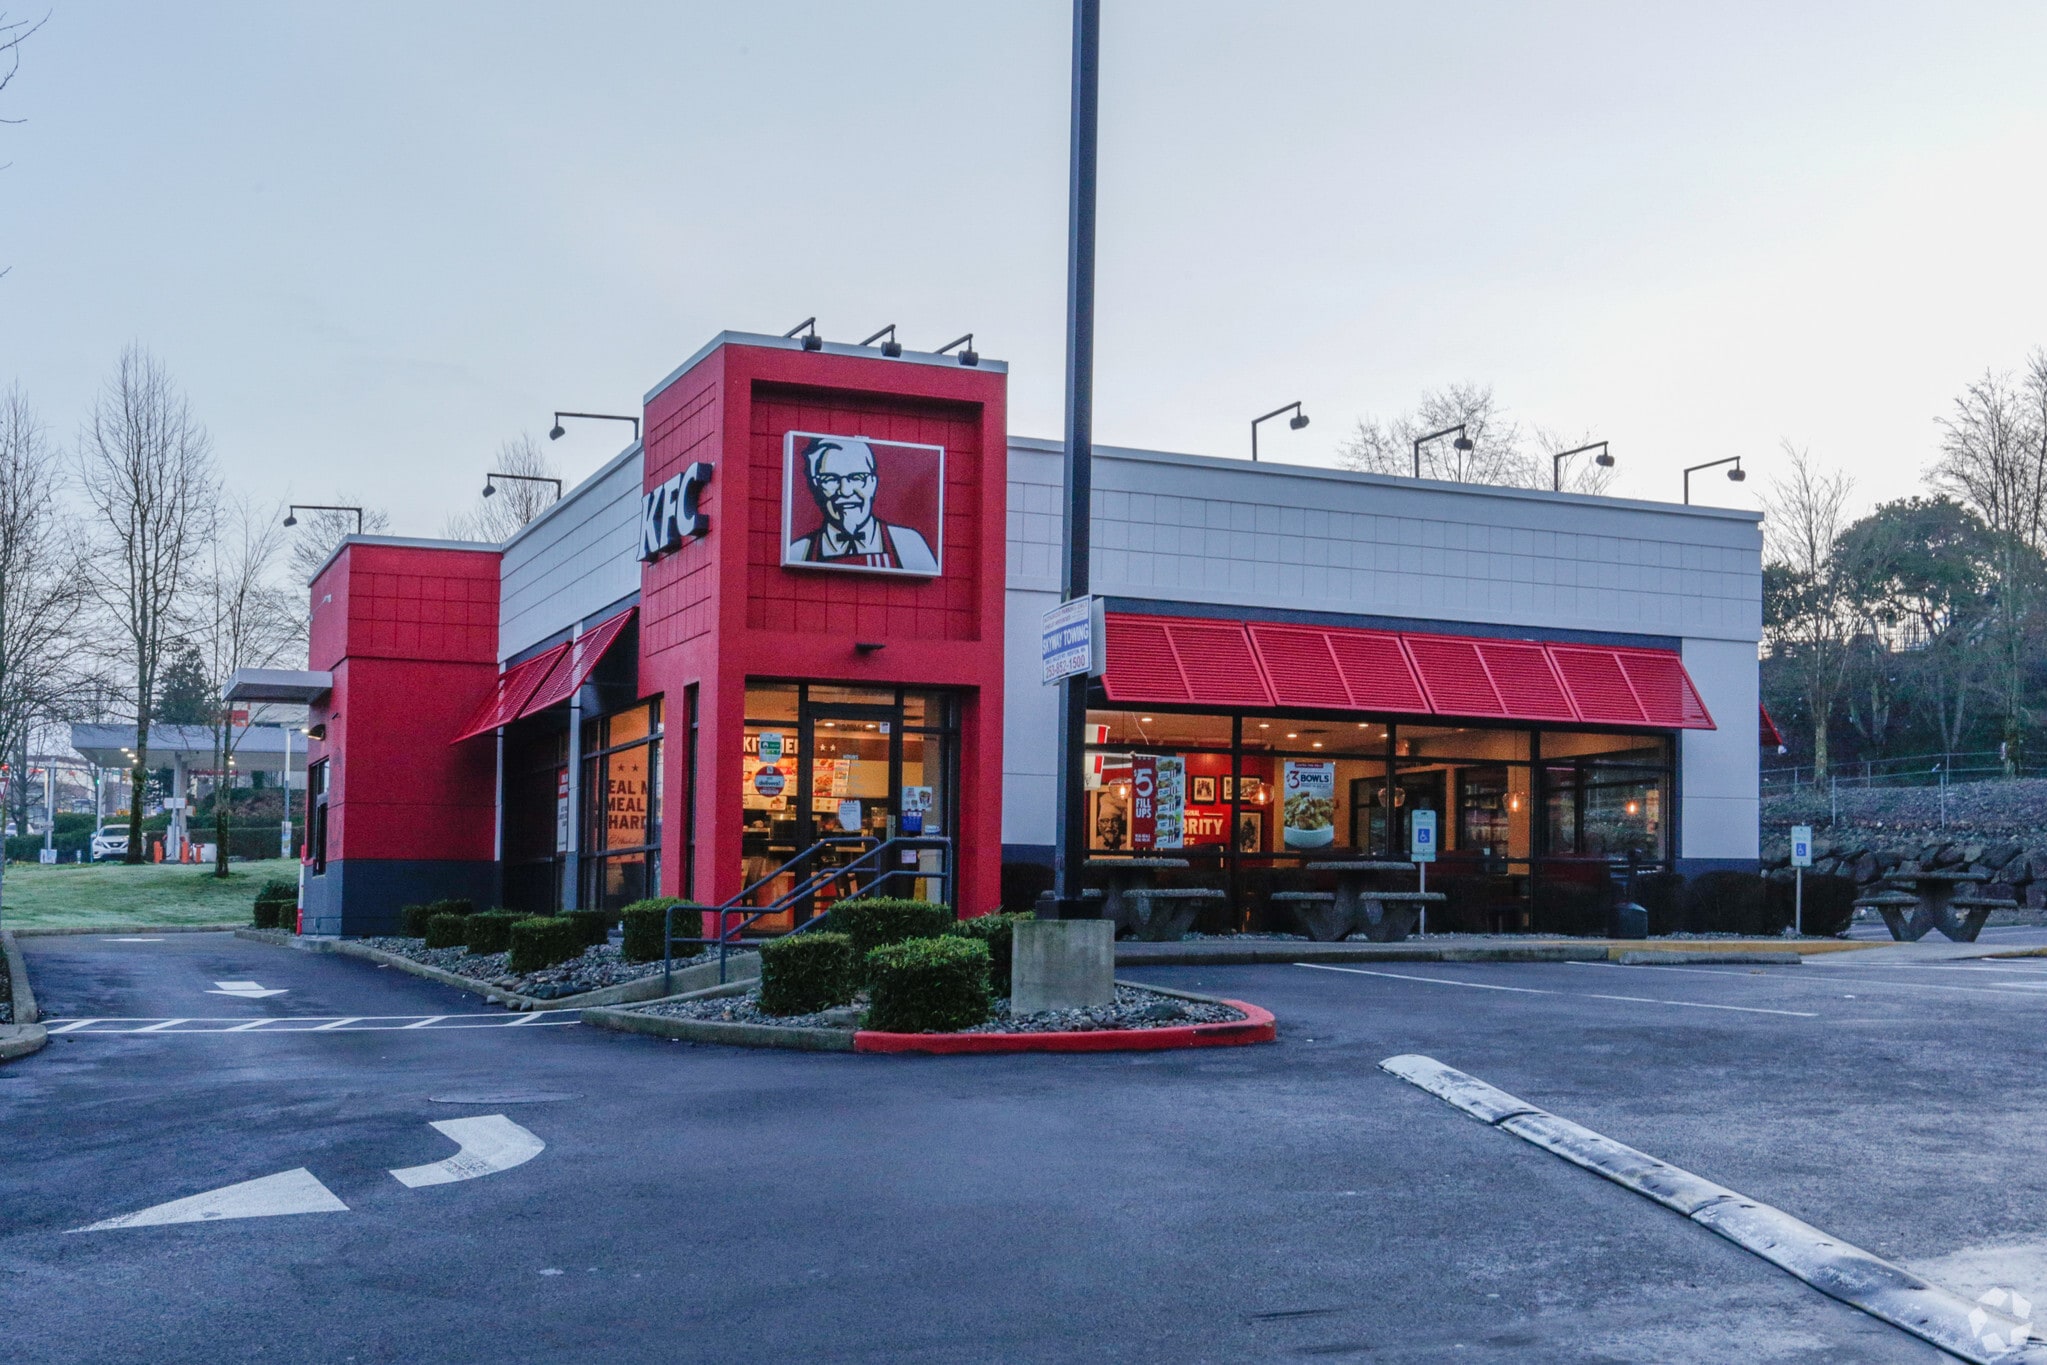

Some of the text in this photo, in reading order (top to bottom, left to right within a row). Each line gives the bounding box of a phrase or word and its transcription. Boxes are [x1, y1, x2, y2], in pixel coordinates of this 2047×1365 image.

[636, 462, 711, 562] KFC
[1063, 624, 1089, 646] TOWING
[1301, 774, 1329, 782] BOWLS
[608, 780, 636, 795] EAL
[1136, 798, 1151, 808] FILL
[1136, 808, 1152, 818] UPS
